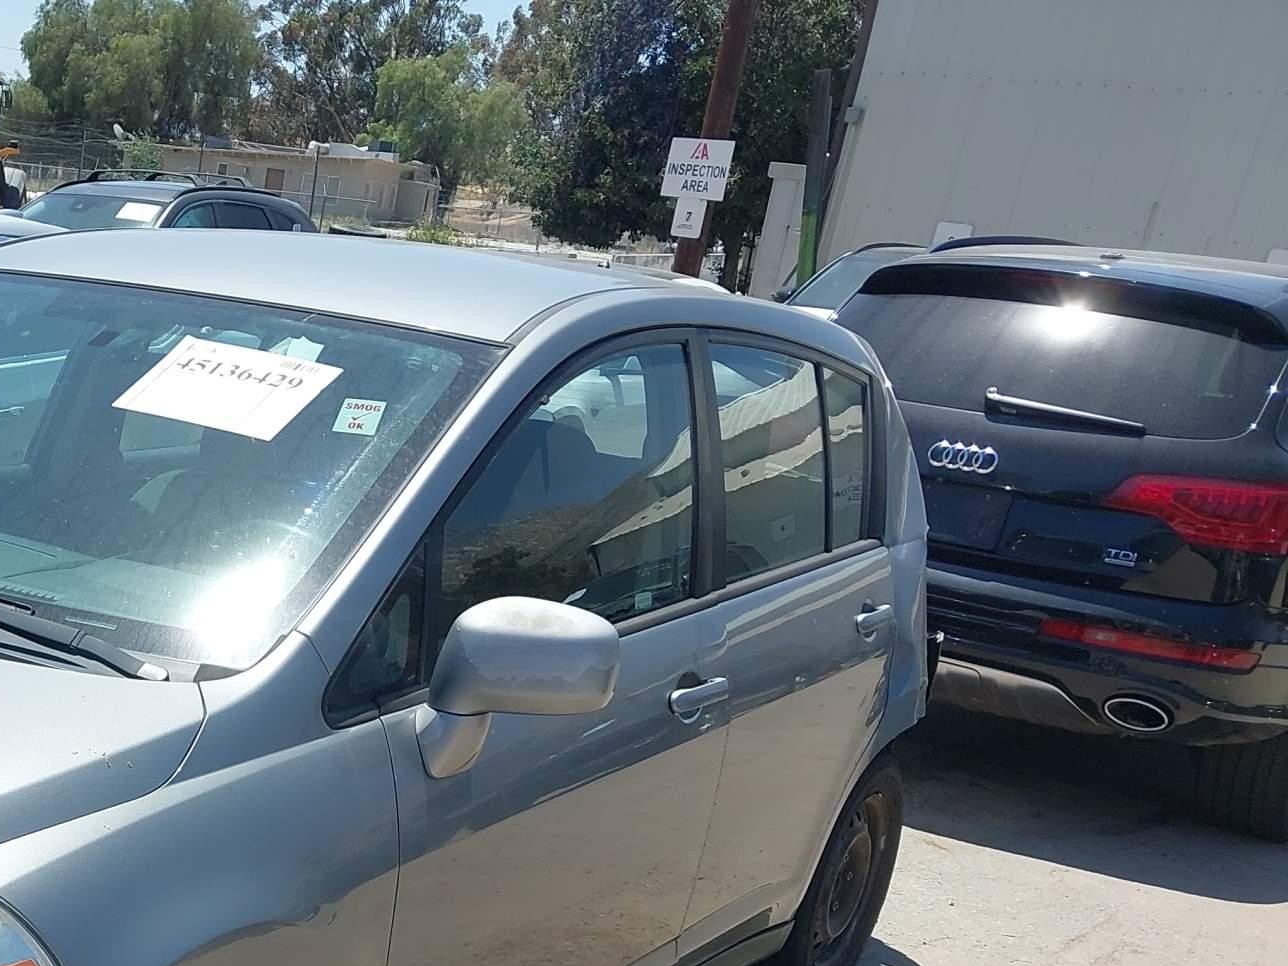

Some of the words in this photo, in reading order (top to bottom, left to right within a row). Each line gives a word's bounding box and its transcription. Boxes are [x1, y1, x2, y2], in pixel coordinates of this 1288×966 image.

[667, 162, 727, 179] INSPECTION
[680, 180, 709, 193] AREA
[686, 211, 693, 222] 7
[175, 357, 304, 390] 45136429
[345, 402, 382, 412] SMOG
[347, 421, 365, 431] OK
[1106, 548, 1138, 562] TDI
